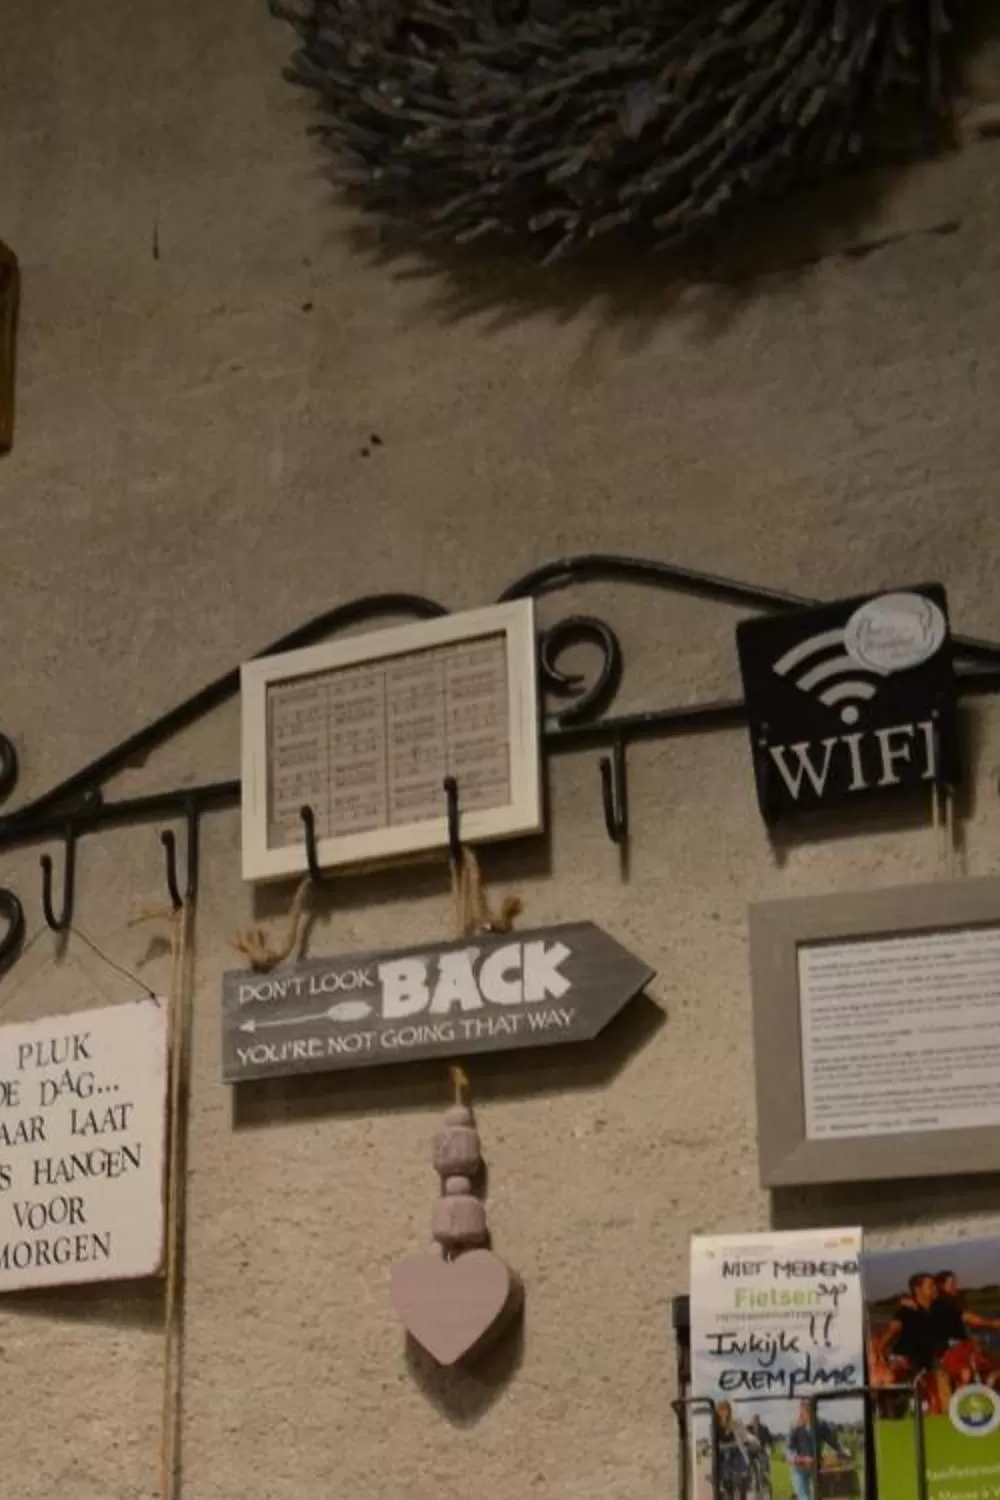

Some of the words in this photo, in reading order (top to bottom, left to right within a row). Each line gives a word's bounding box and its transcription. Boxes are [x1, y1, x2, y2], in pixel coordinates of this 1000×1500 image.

[769, 720, 937, 800] WIFI
[238, 974, 302, 1005] DON'T
[308, 968, 376, 996] LOOK
[377, 940, 574, 1020] BACK
[17, 1032, 93, 1069] PLUK
[237, 1036, 323, 1066] YOU'RE
[327, 1031, 376, 1057] NOT
[380, 1024, 456, 1050] GOING
[462, 1015, 524, 1043] THAT
[527, 1008, 577, 1035] WAY
[40, 1069, 120, 1107] DAG...
[70, 1104, 135, 1136] LAAT
[32, 1144, 143, 1186] HANGEN
[12, 1197, 86, 1231] VOOR
[734, 1287, 821, 1309] Fietsen
